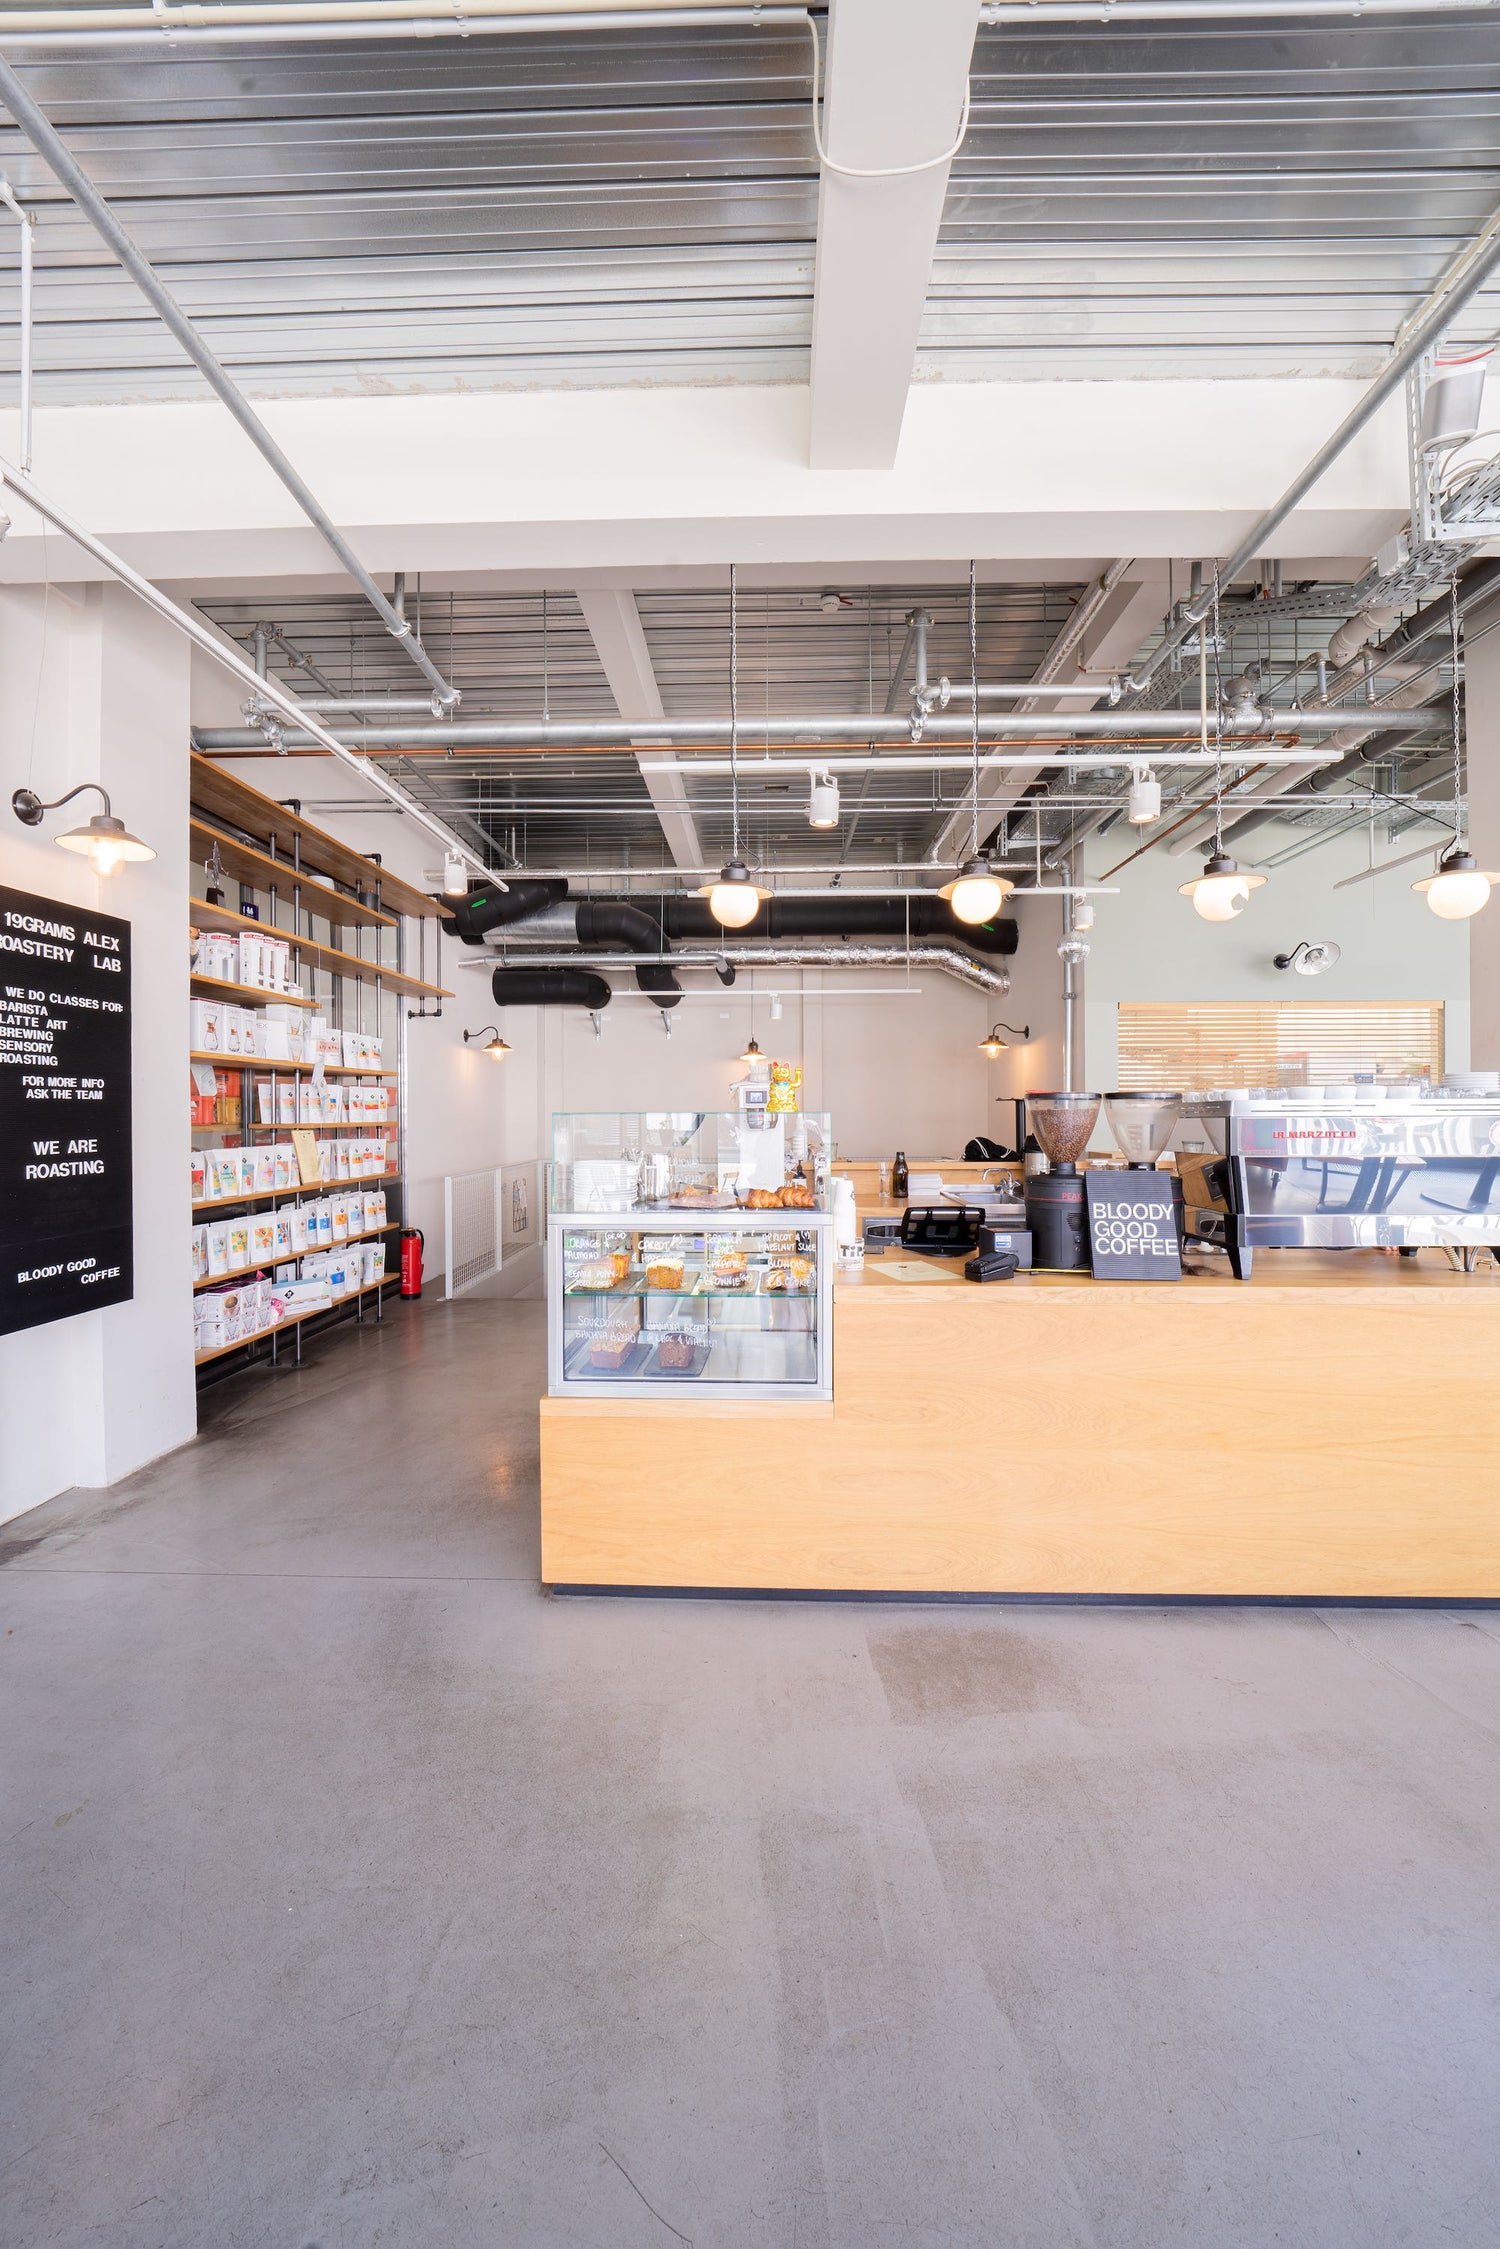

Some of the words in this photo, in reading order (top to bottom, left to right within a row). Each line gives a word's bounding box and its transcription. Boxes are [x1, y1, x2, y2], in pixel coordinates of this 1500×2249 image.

[4, 912, 76, 941] 19GRAMS
[83, 931, 120, 952] ALEX
[0, 934, 75, 963] OASTERY
[93, 954, 121, 973] LAB
[5, 986, 25, 999] WE
[28, 989, 45, 1001] DO
[49, 993, 99, 1010] CLASSES
[0, 1000, 48, 1016] BARISTA
[0, 1013, 39, 1028] LATTE
[46, 1019, 68, 1031] ART
[0, 1026, 54, 1042] BREWING
[0, 1039, 53, 1054] SENSORY
[0, 1052, 58, 1066] ROASTING
[22, 1075, 45, 1087] FOR
[48, 1076, 77, 1088] MORE
[81, 1078, 104, 1089] INFO
[26, 1089, 49, 1100] ASK
[51, 1089, 72, 1100] THE
[75, 1090, 103, 1101] TEAM
[33, 1140, 60, 1156] WE
[67, 1139, 98, 1154] ARE
[25, 1159, 105, 1180] ROASTING
[1093, 1203, 1174, 1220] BLOODY
[1094, 1221, 1158, 1238] GOOD
[1095, 1238, 1179, 1255] COFFEE
[17, 1263, 64, 1283] BLOODY
[66, 1257, 96, 1273] GOOD
[80, 1266, 121, 1285] COFFEE
